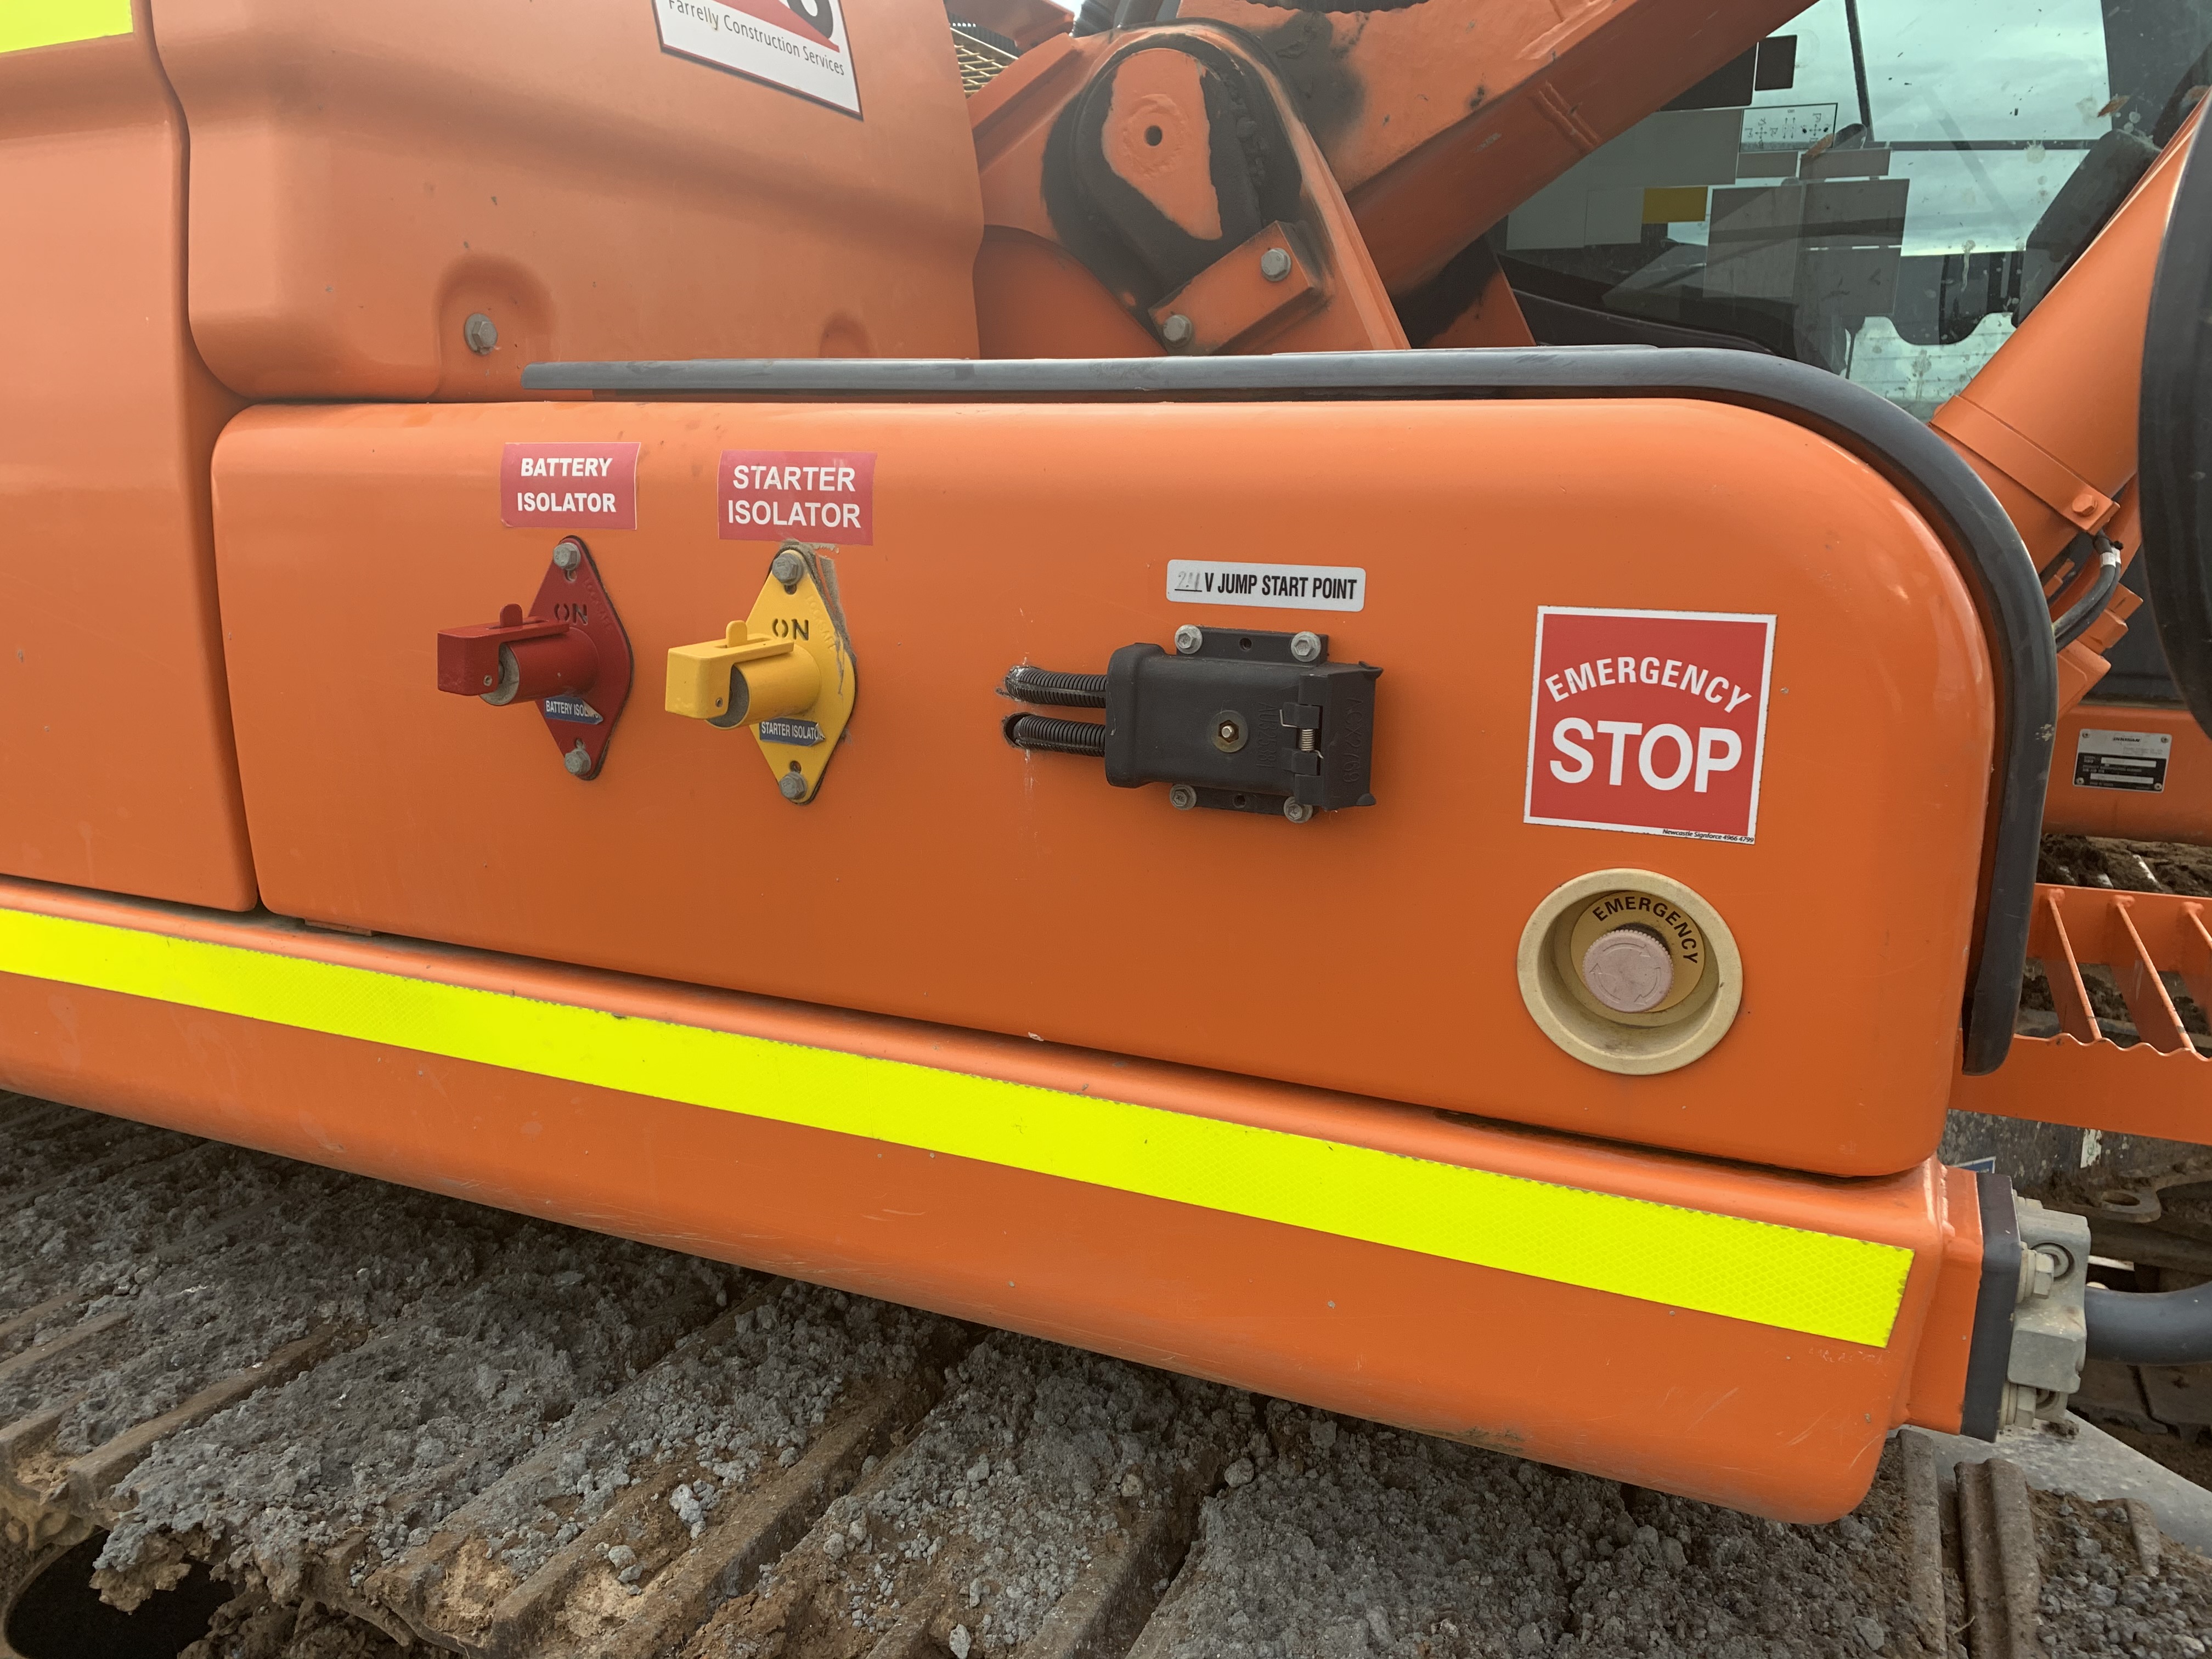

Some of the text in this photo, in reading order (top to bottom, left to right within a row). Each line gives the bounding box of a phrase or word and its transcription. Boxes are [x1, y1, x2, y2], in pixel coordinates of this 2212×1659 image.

[669, 0, 718, 30] Farrelly
[724, 15, 800, 57] Construction
[803, 46, 844, 75] Services
[521, 458, 613, 477] BATTERY
[732, 465, 856, 492] STARTER
[517, 492, 617, 512] ISOLATOR
[728, 500, 861, 528] ISOLATOR
[1205, 572, 1214, 592] V
[1217, 573, 1257, 594] JUMP
[1262, 575, 1308, 597] START
[1312, 578, 1357, 600] POINT
[554, 603, 588, 624] ON
[772, 618, 809, 641] ON
[1545, 657, 1752, 713] EMERGENCY
[546, 700, 572, 714] BATTERY
[761, 721, 790, 736] STARTER
[1550, 717, 1742, 793] STOP
[1662, 829, 1693, 837] Newcastle
[1694, 832, 1722, 840] Signforce
[1592, 896, 1698, 964] EMERGENCY
